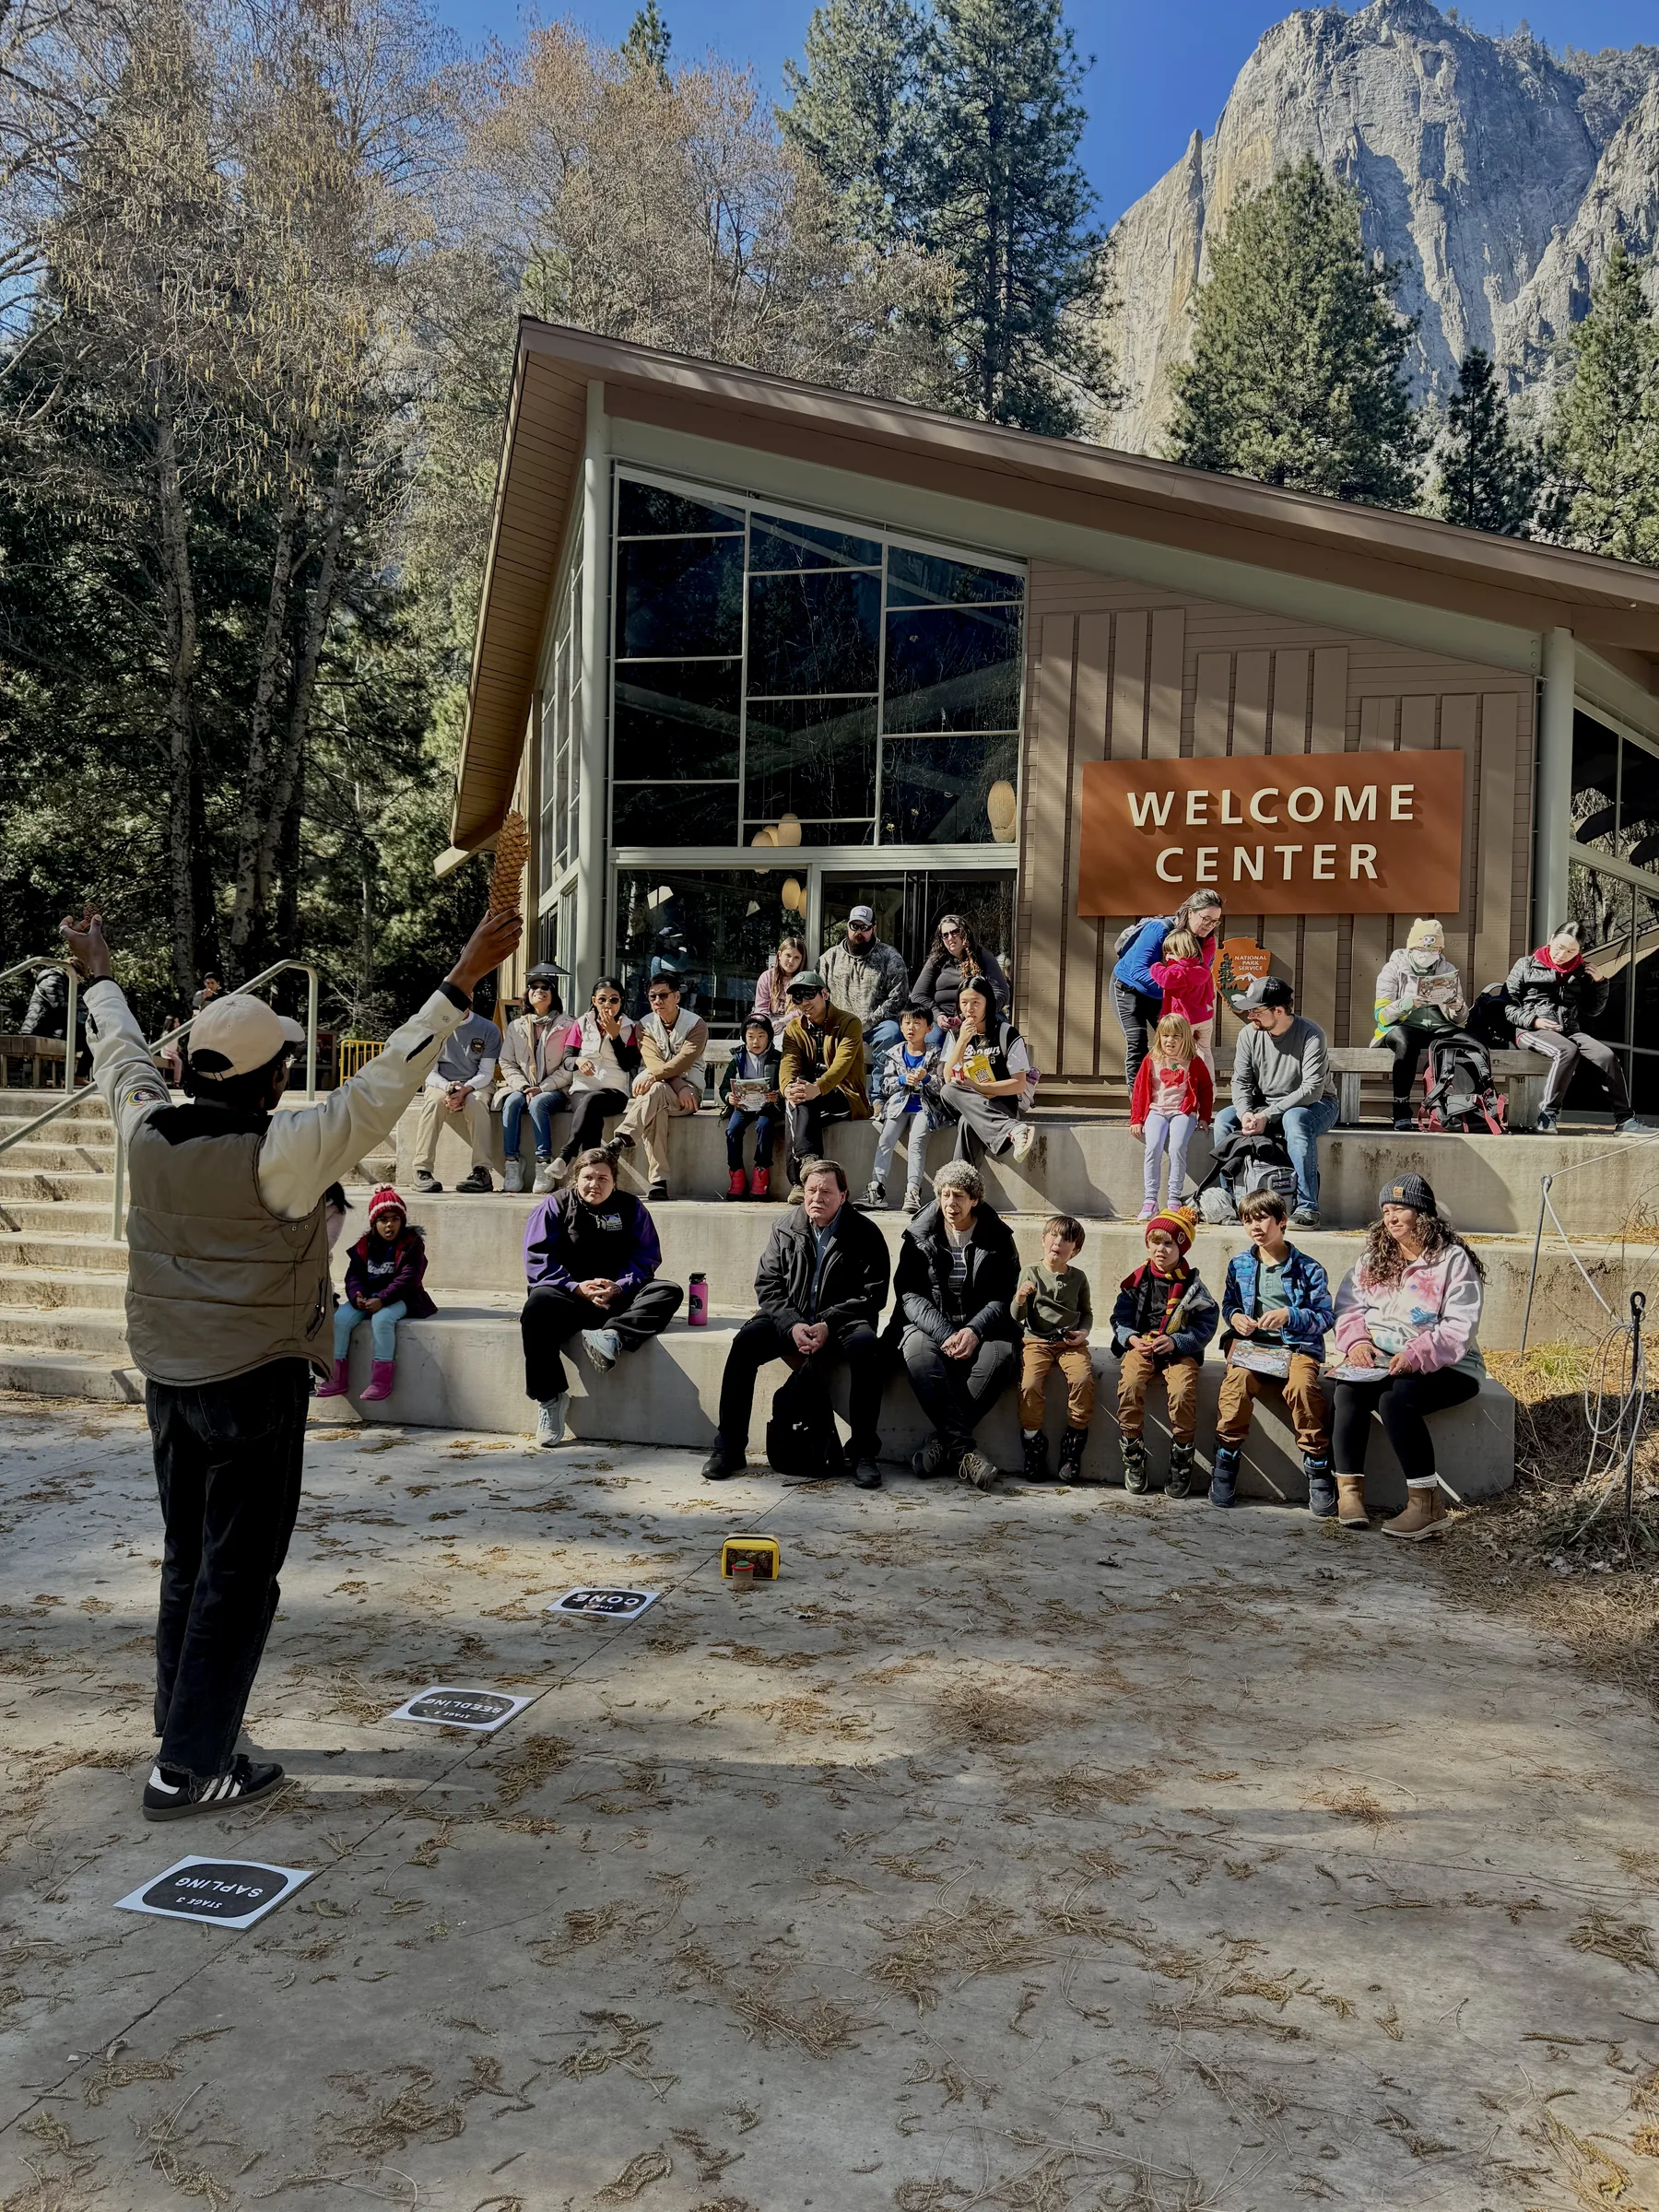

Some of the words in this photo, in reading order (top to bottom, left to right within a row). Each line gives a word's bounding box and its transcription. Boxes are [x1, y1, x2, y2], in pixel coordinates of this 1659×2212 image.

[1127, 784, 1414, 826] WELCOME
[1156, 843, 1378, 882] CENTER
[572, 1594, 640, 1606] CONE
[424, 1698, 503, 1713] SEEDLING
[443, 1711, 470, 1719] STAGE
[175, 1877, 263, 1897] SAPLING
[187, 1899, 222, 1908] STAGE
